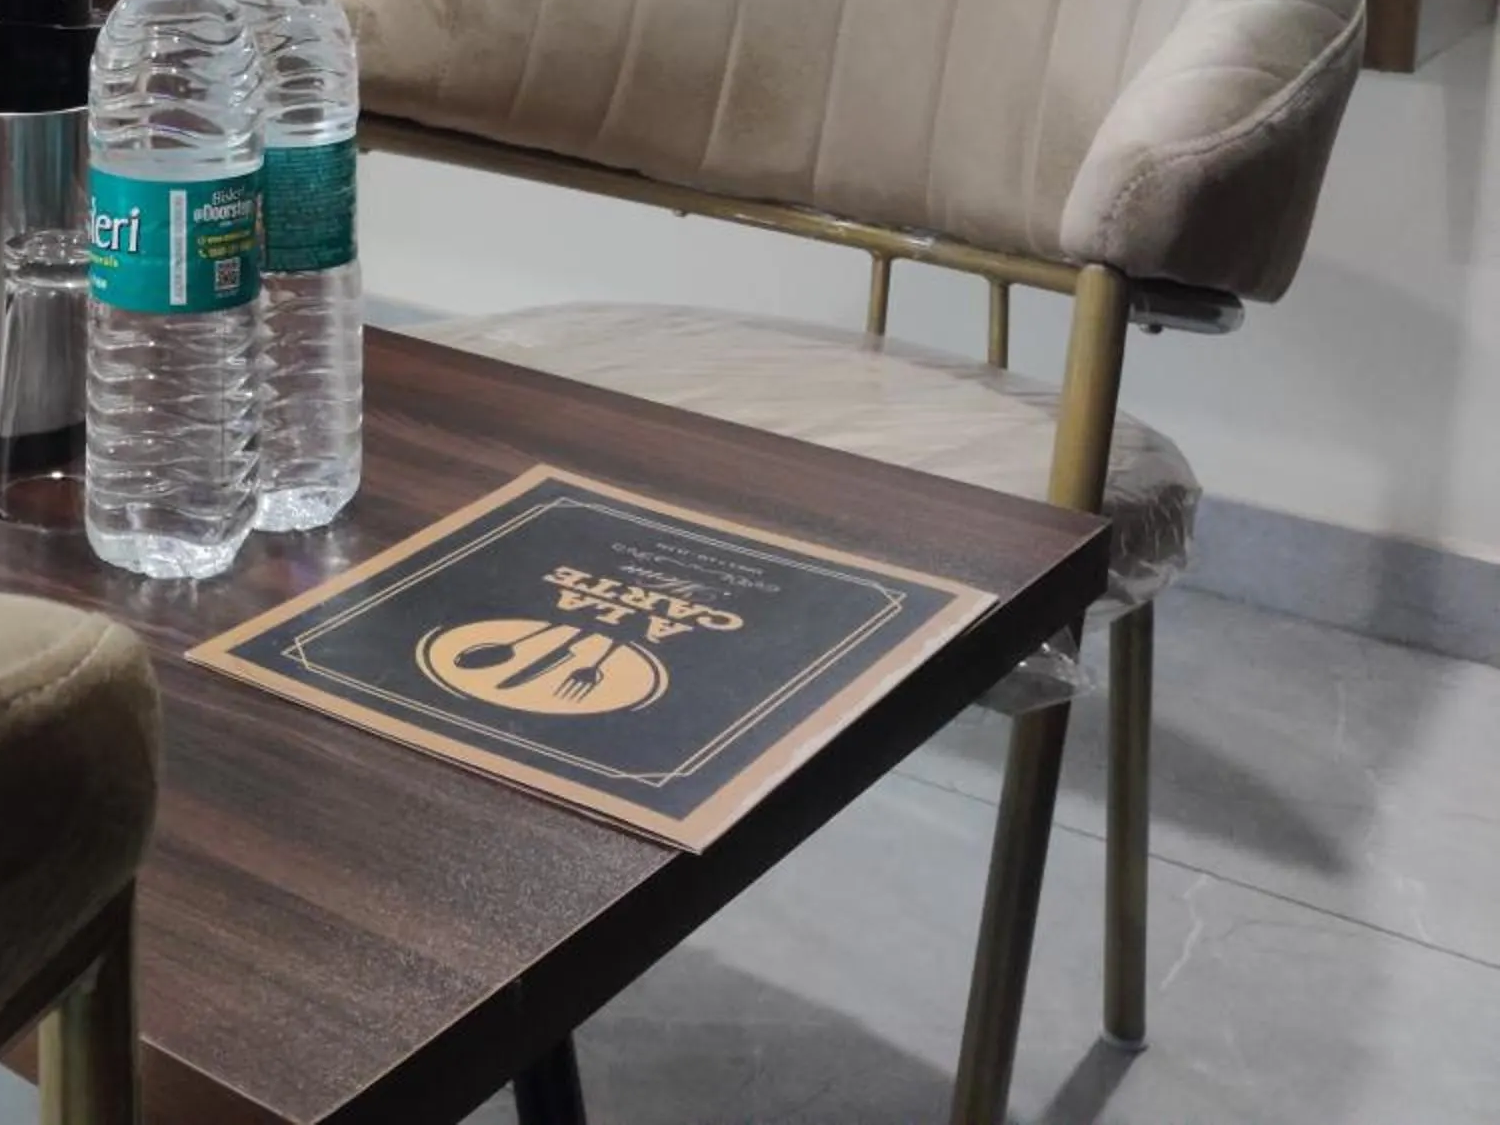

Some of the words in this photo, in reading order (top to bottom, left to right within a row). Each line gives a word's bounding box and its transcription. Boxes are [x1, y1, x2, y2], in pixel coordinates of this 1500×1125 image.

[88, 195, 140, 252] leri
[542, 566, 744, 631] CARTE
[556, 590, 636, 625] LA
